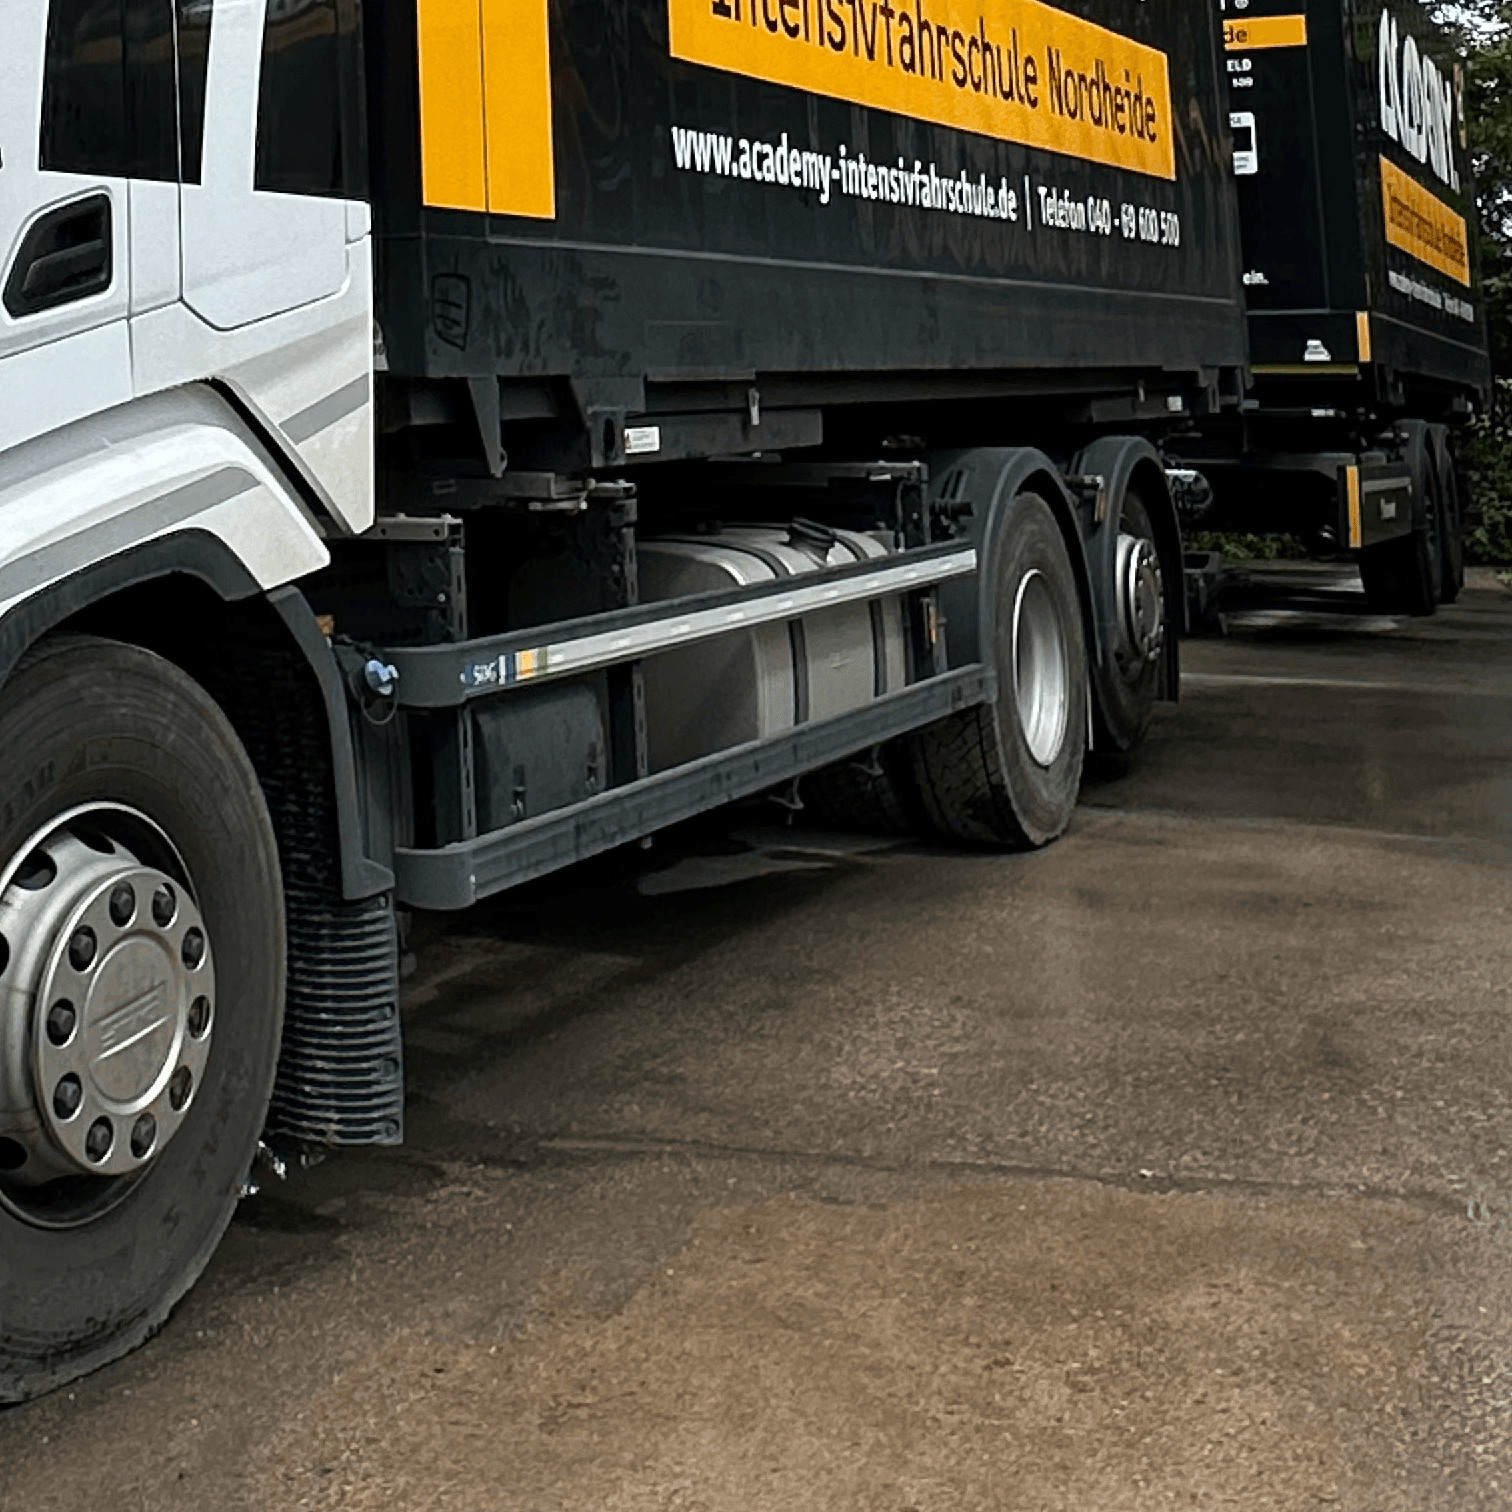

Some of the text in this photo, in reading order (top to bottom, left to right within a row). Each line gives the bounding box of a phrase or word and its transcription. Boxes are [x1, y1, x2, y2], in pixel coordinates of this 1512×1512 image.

[1046, 45, 1157, 143] Nordheide
[671, 125, 1018, 222] www.academy-intensivfahrschule.de
[1037, 185, 1086, 231] Telefon
